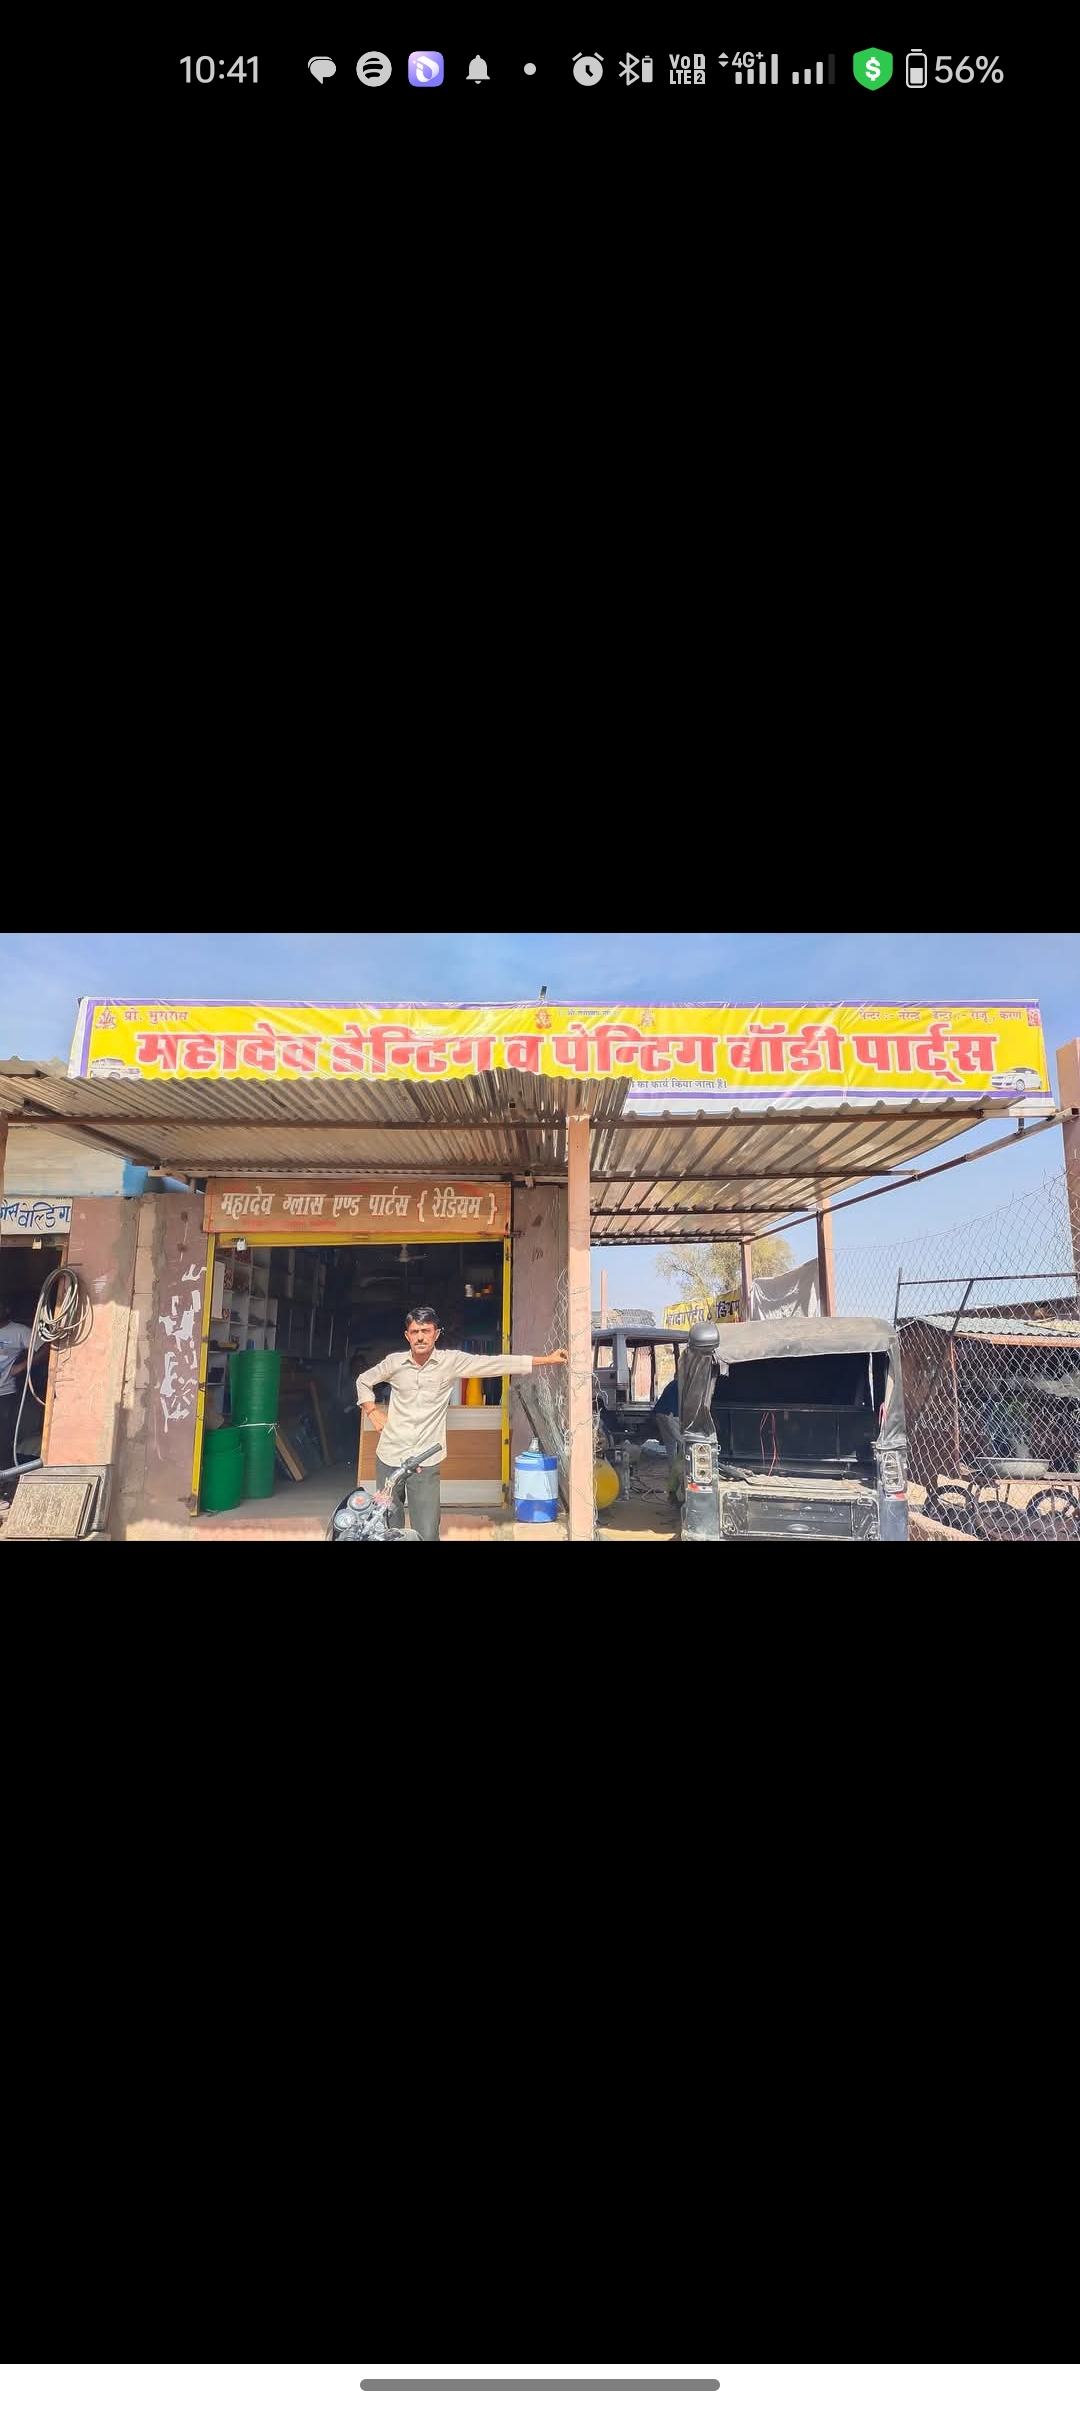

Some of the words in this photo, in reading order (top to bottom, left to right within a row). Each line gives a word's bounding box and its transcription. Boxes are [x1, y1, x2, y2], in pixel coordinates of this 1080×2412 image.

[137, 1022, 323, 1072] महादेव
[503, 1035, 545, 1073] व
[725, 1024, 846, 1072] बॉडी
[852, 1023, 998, 1084] पार्ट्स
[671, 1077, 692, 1089] किया
[695, 1080, 715, 1089] जाता
[221, 1185, 276, 1220] महादेव
[282, 1193, 328, 1216] ग्लास
[332, 1194, 363, 1218] एण्ड
[431, 1186, 484, 1219] रेडियम
